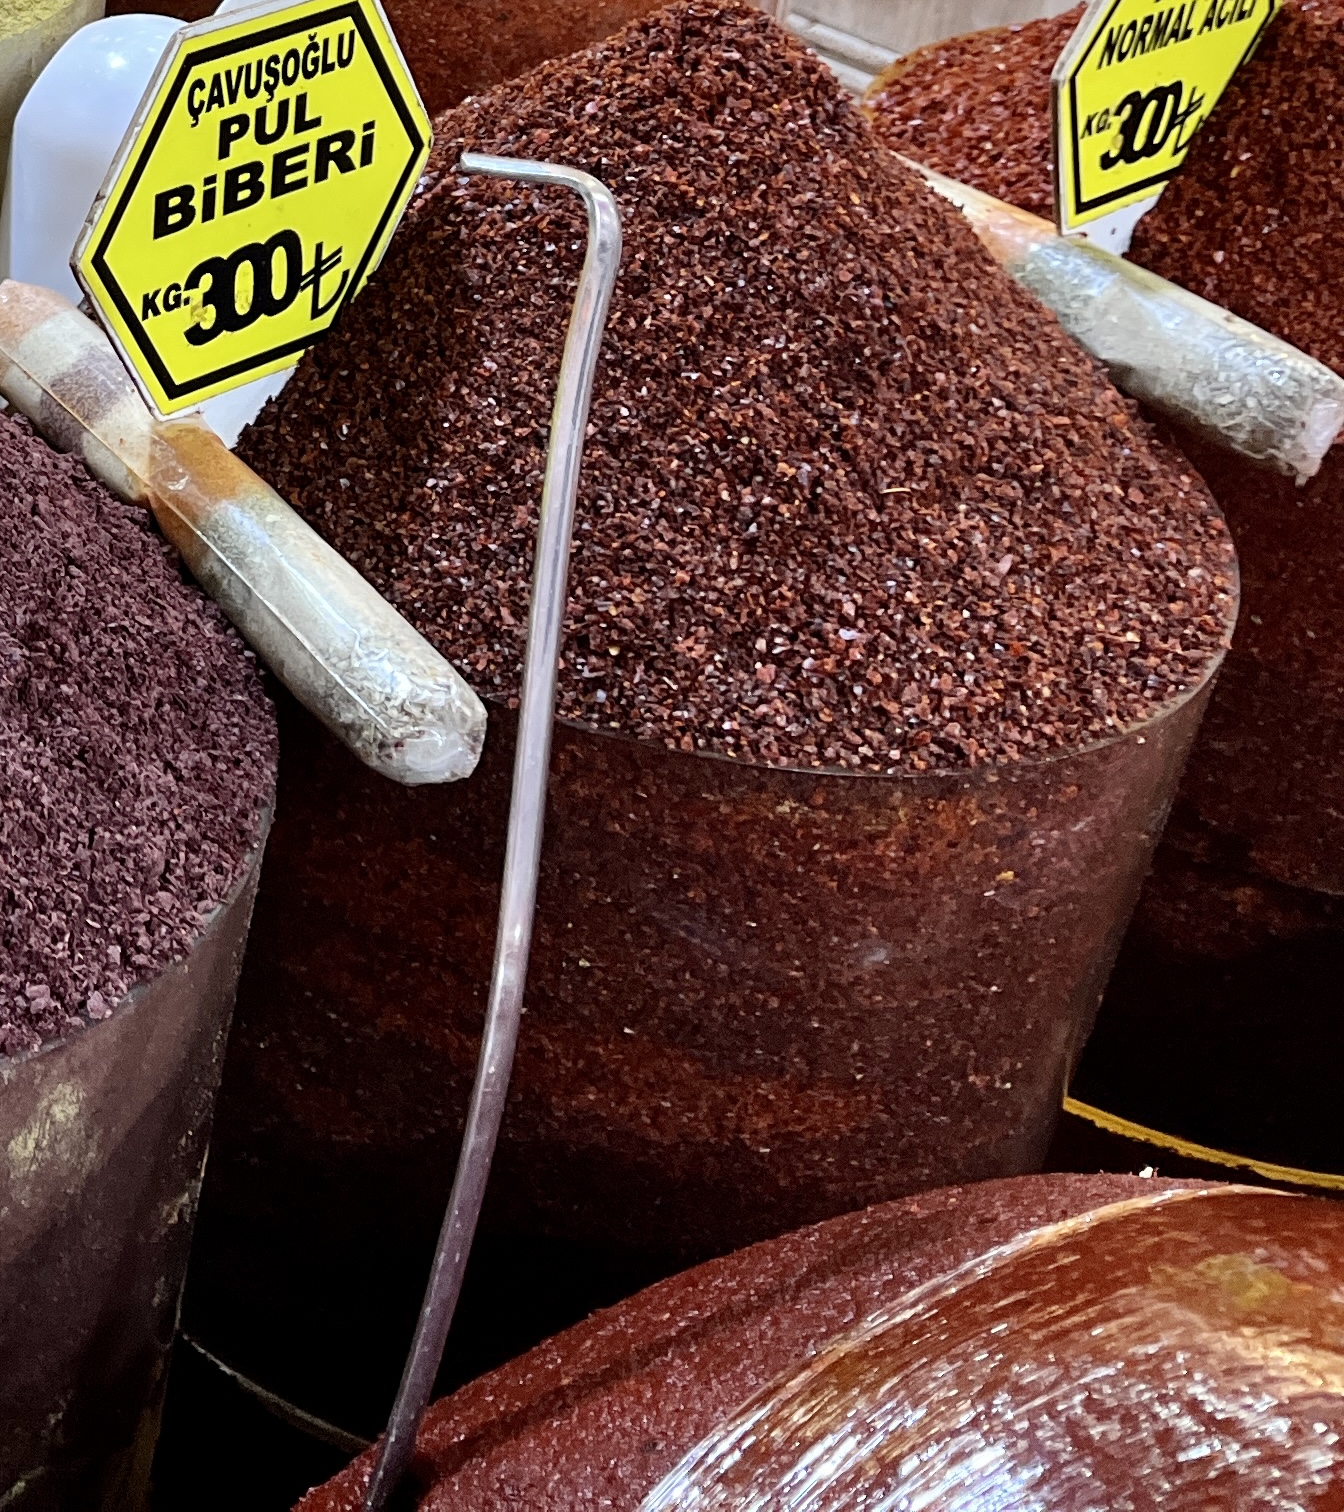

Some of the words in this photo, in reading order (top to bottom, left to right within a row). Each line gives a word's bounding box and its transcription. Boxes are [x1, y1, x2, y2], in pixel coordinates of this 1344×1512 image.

[1097, 0, 1197, 70] NORMAL
[187, 29, 356, 127] ÇAVUŞOĞLU
[218, 91, 322, 161] PUL
